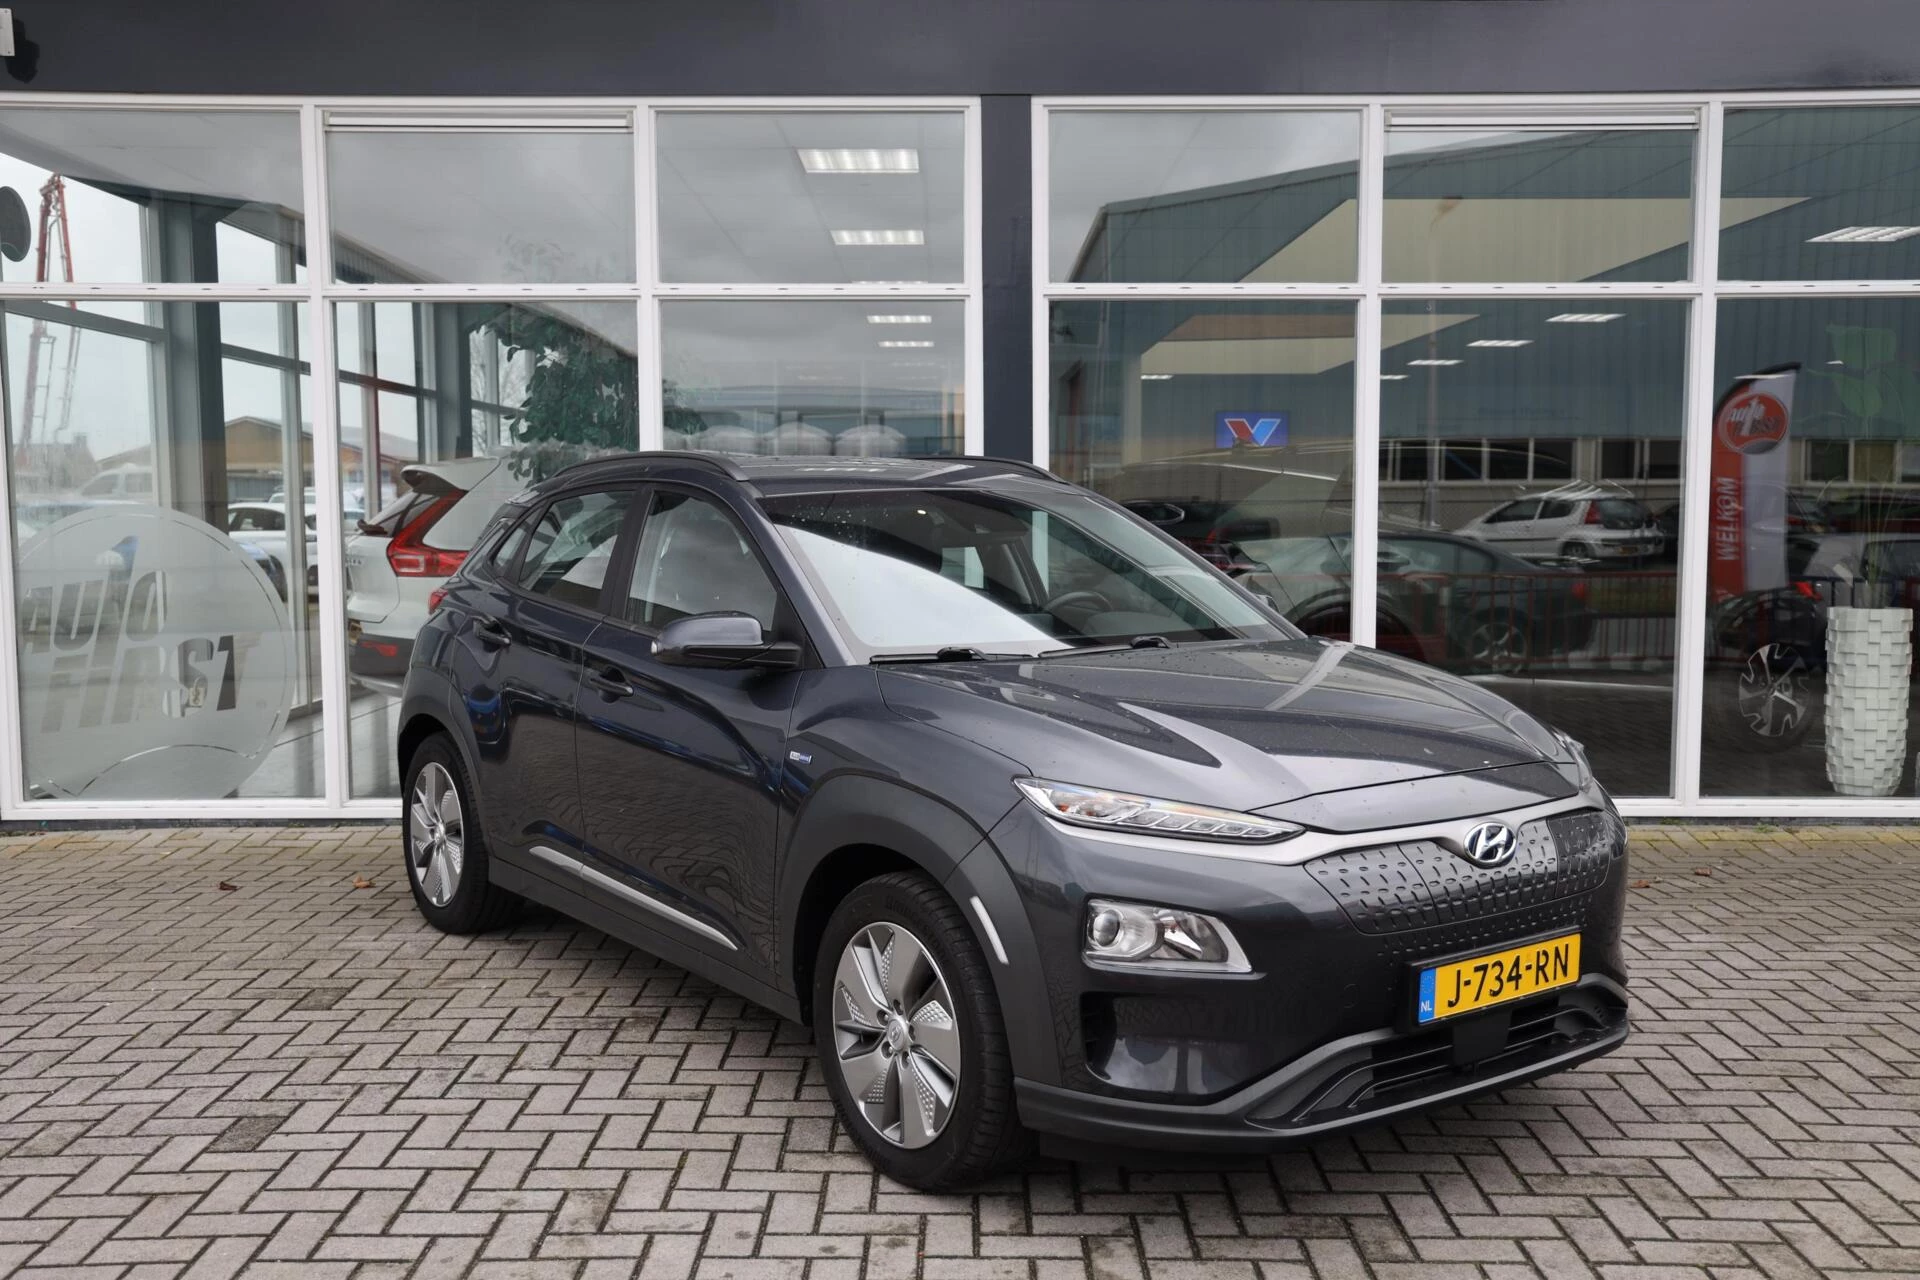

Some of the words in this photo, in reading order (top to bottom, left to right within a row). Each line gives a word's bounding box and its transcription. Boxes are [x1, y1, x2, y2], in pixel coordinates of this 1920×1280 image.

[1716, 477, 1738, 560] WELKOM
[1420, 1000, 1432, 1013] NL
[1447, 943, 1569, 1008] J-734-RN
